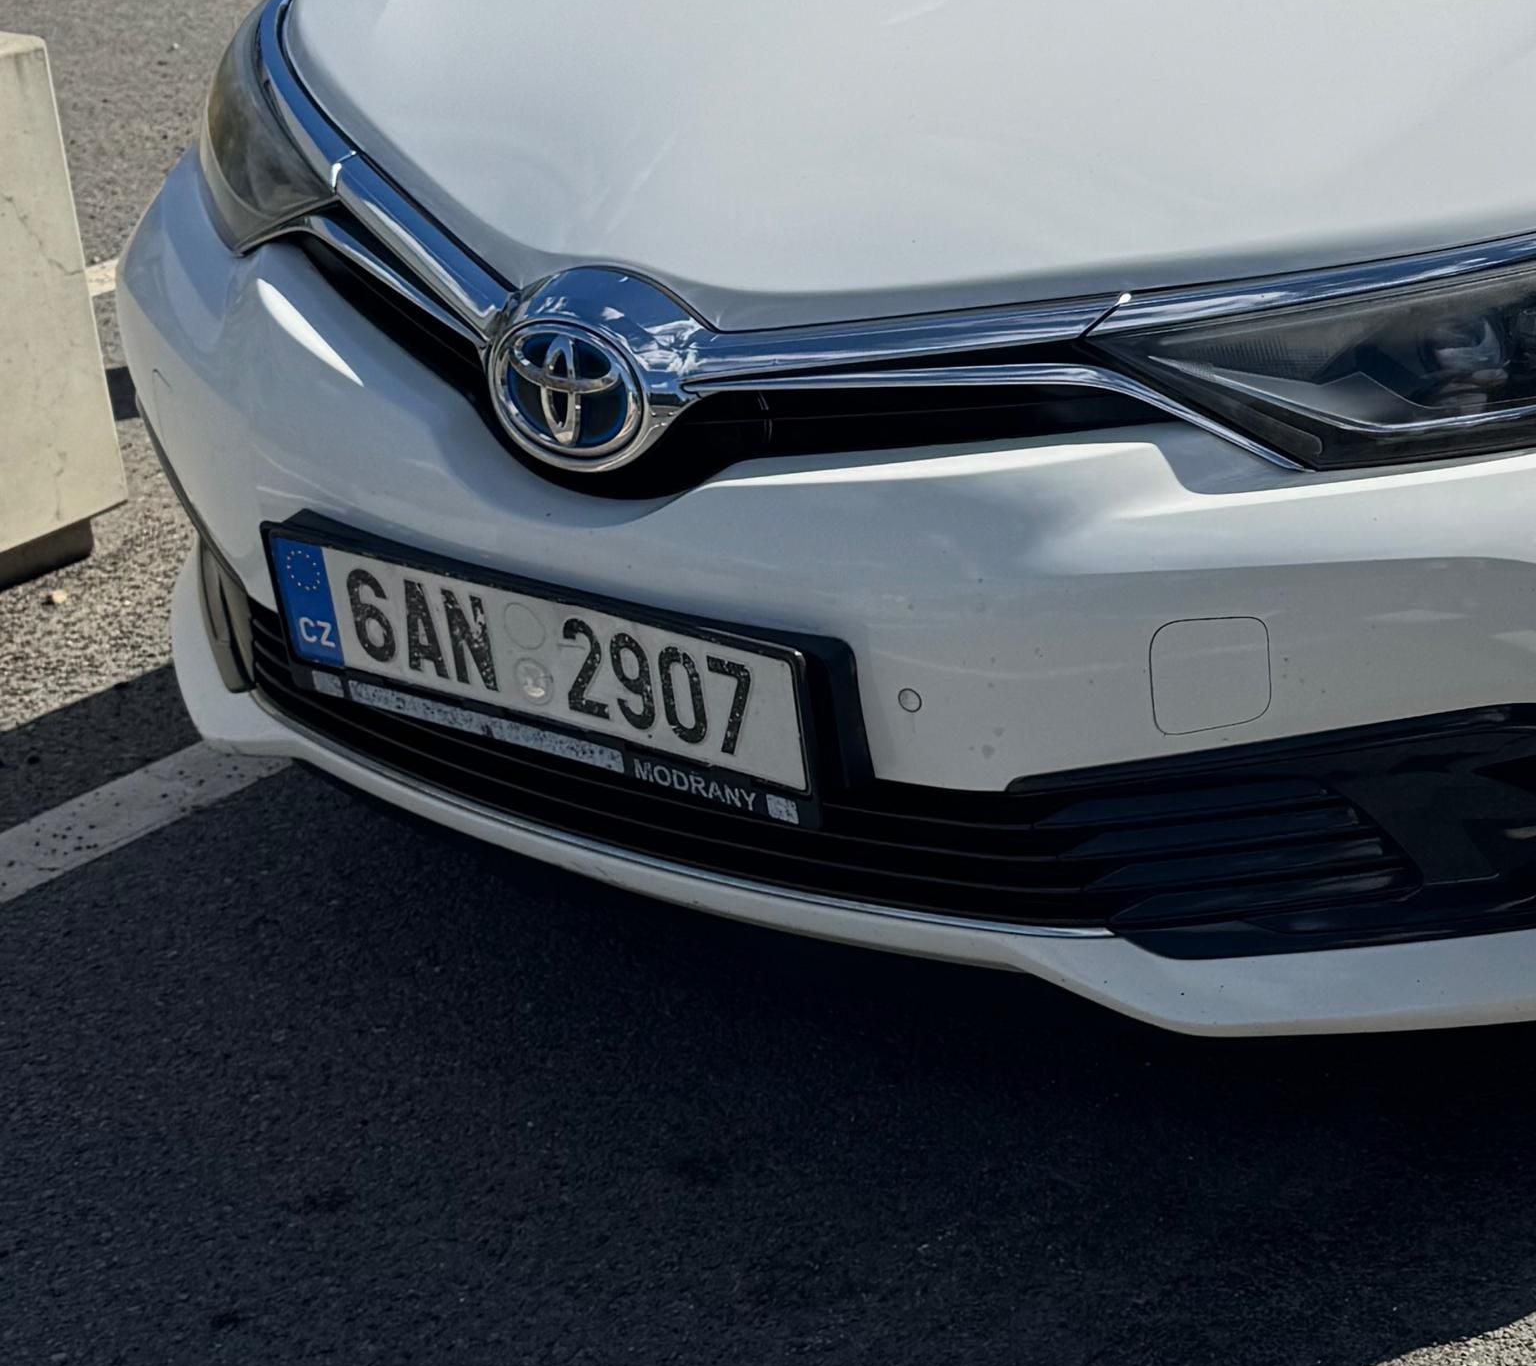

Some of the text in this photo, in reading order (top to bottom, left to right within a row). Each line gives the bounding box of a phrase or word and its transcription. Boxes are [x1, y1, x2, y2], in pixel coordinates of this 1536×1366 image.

[299, 616, 336, 648] CZ
[345, 568, 752, 755] 6AN 2907
